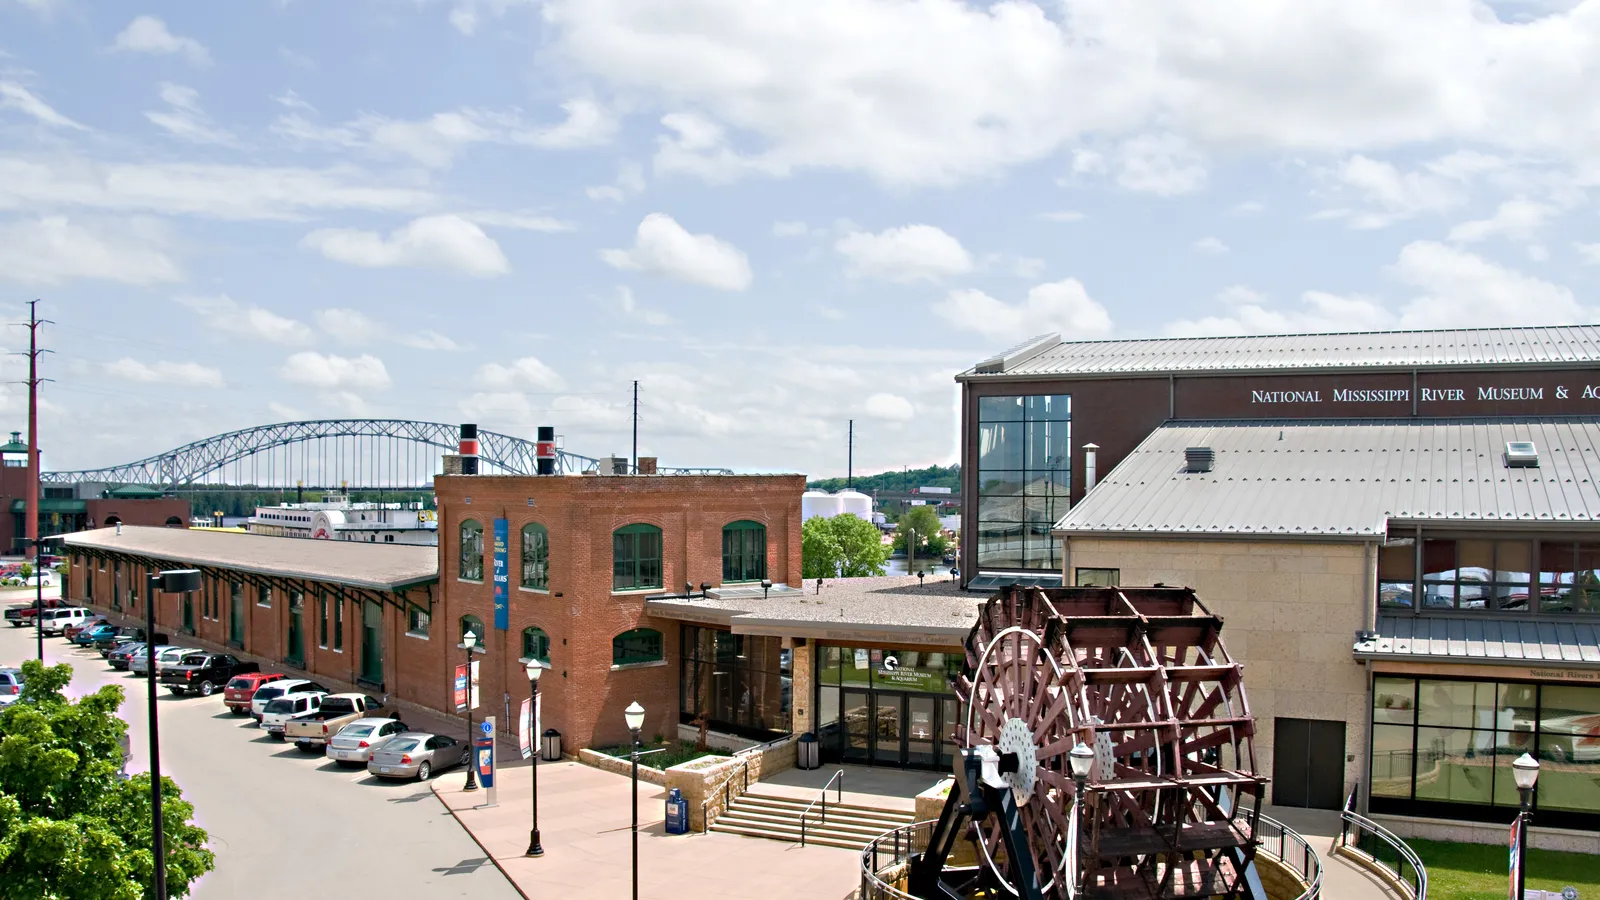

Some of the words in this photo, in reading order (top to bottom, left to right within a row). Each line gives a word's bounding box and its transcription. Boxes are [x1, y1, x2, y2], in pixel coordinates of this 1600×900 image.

[1251, 389, 1323, 403] NATIONAL
[1333, 388, 1410, 403] MISSISSIPPI
[1421, 387, 1466, 402] RIVER
[1477, 386, 1544, 400] MUSEUM
[1555, 385, 1569, 399] &
[1530, 669, 1564, 678] National
[1567, 671, 1594, 679] Rivers
